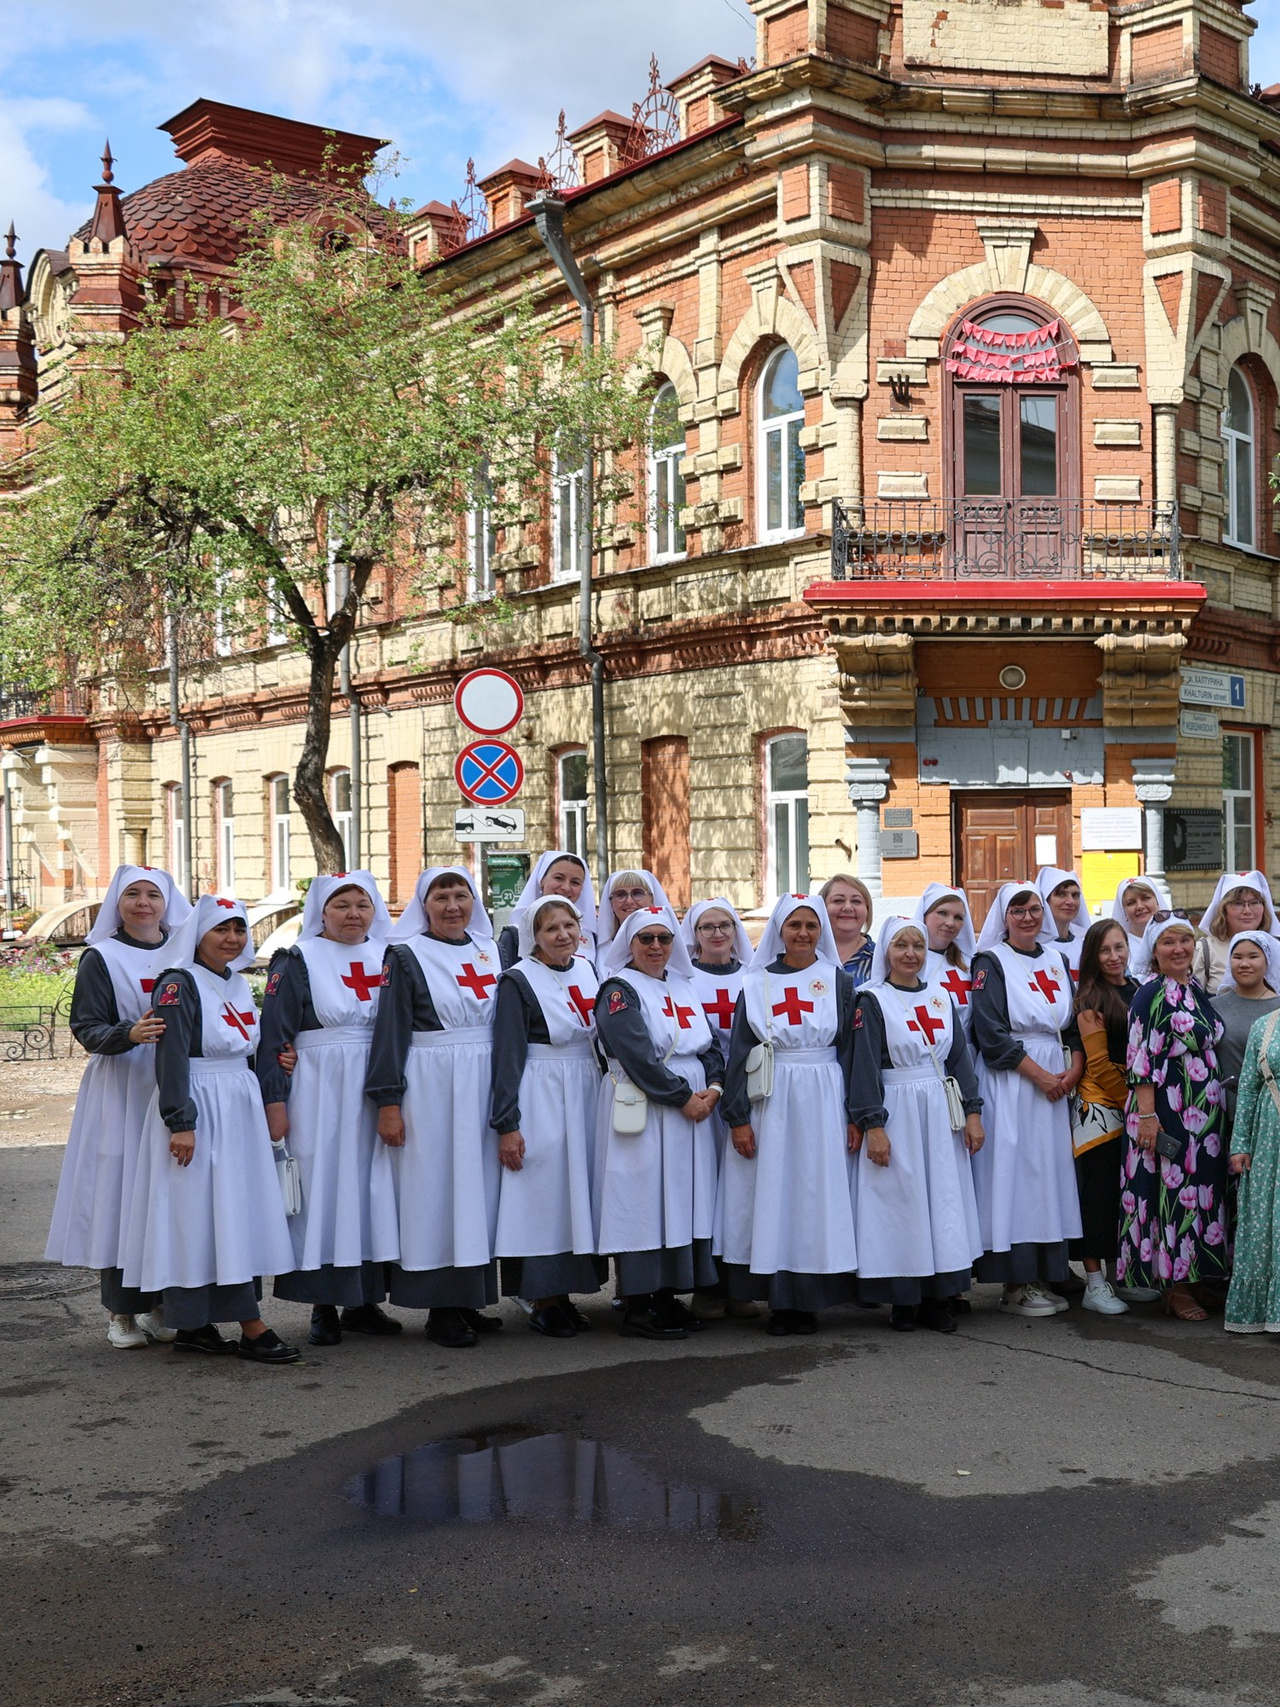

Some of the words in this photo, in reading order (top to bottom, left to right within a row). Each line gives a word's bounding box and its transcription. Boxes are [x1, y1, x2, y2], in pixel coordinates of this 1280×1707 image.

[1195, 676, 1224, 687] ХАЛТУРИНА
[1184, 688, 1212, 699] KHALTURIN
[1235, 683, 1239, 700] 1
